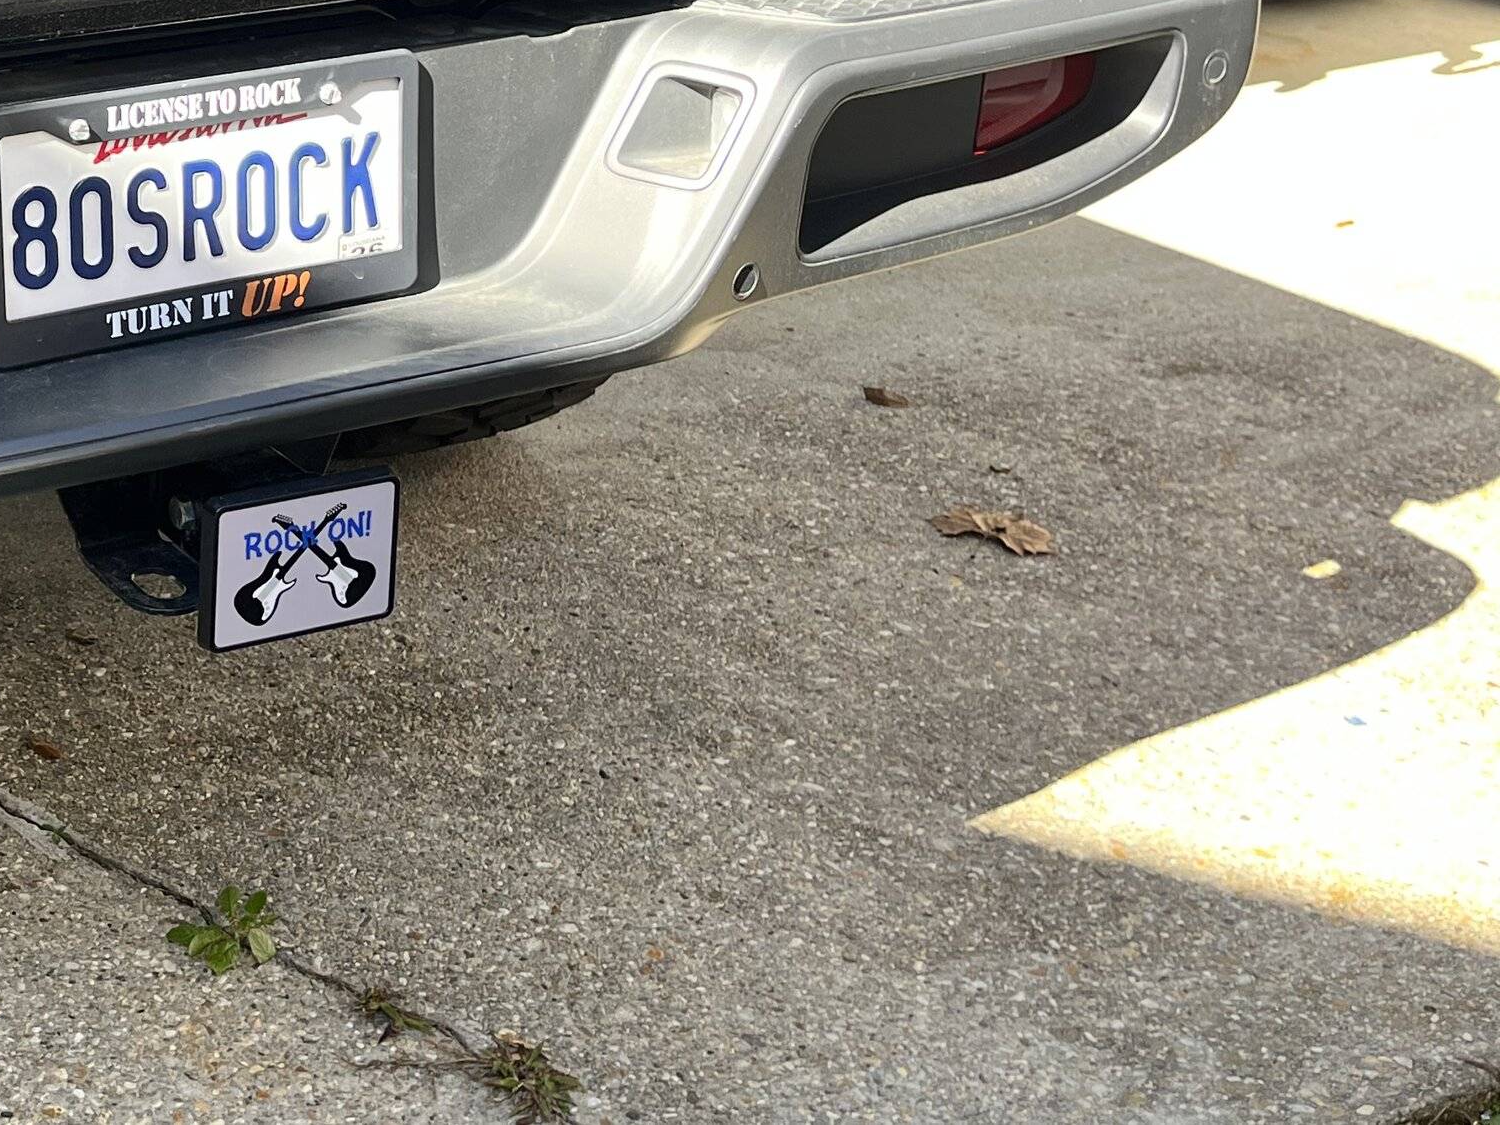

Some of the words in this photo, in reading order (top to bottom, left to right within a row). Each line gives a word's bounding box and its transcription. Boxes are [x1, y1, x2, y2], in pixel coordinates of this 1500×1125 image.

[106, 92, 203, 133] LICENSE
[205, 87, 238, 117] TO
[239, 77, 302, 112] ROCK
[11, 130, 382, 290] 80SROCK
[105, 297, 194, 339] TURN
[201, 289, 234, 321] IT
[241, 270, 312, 318] UP!
[243, 520, 319, 561] ROCK
[327, 510, 373, 543] ON!
